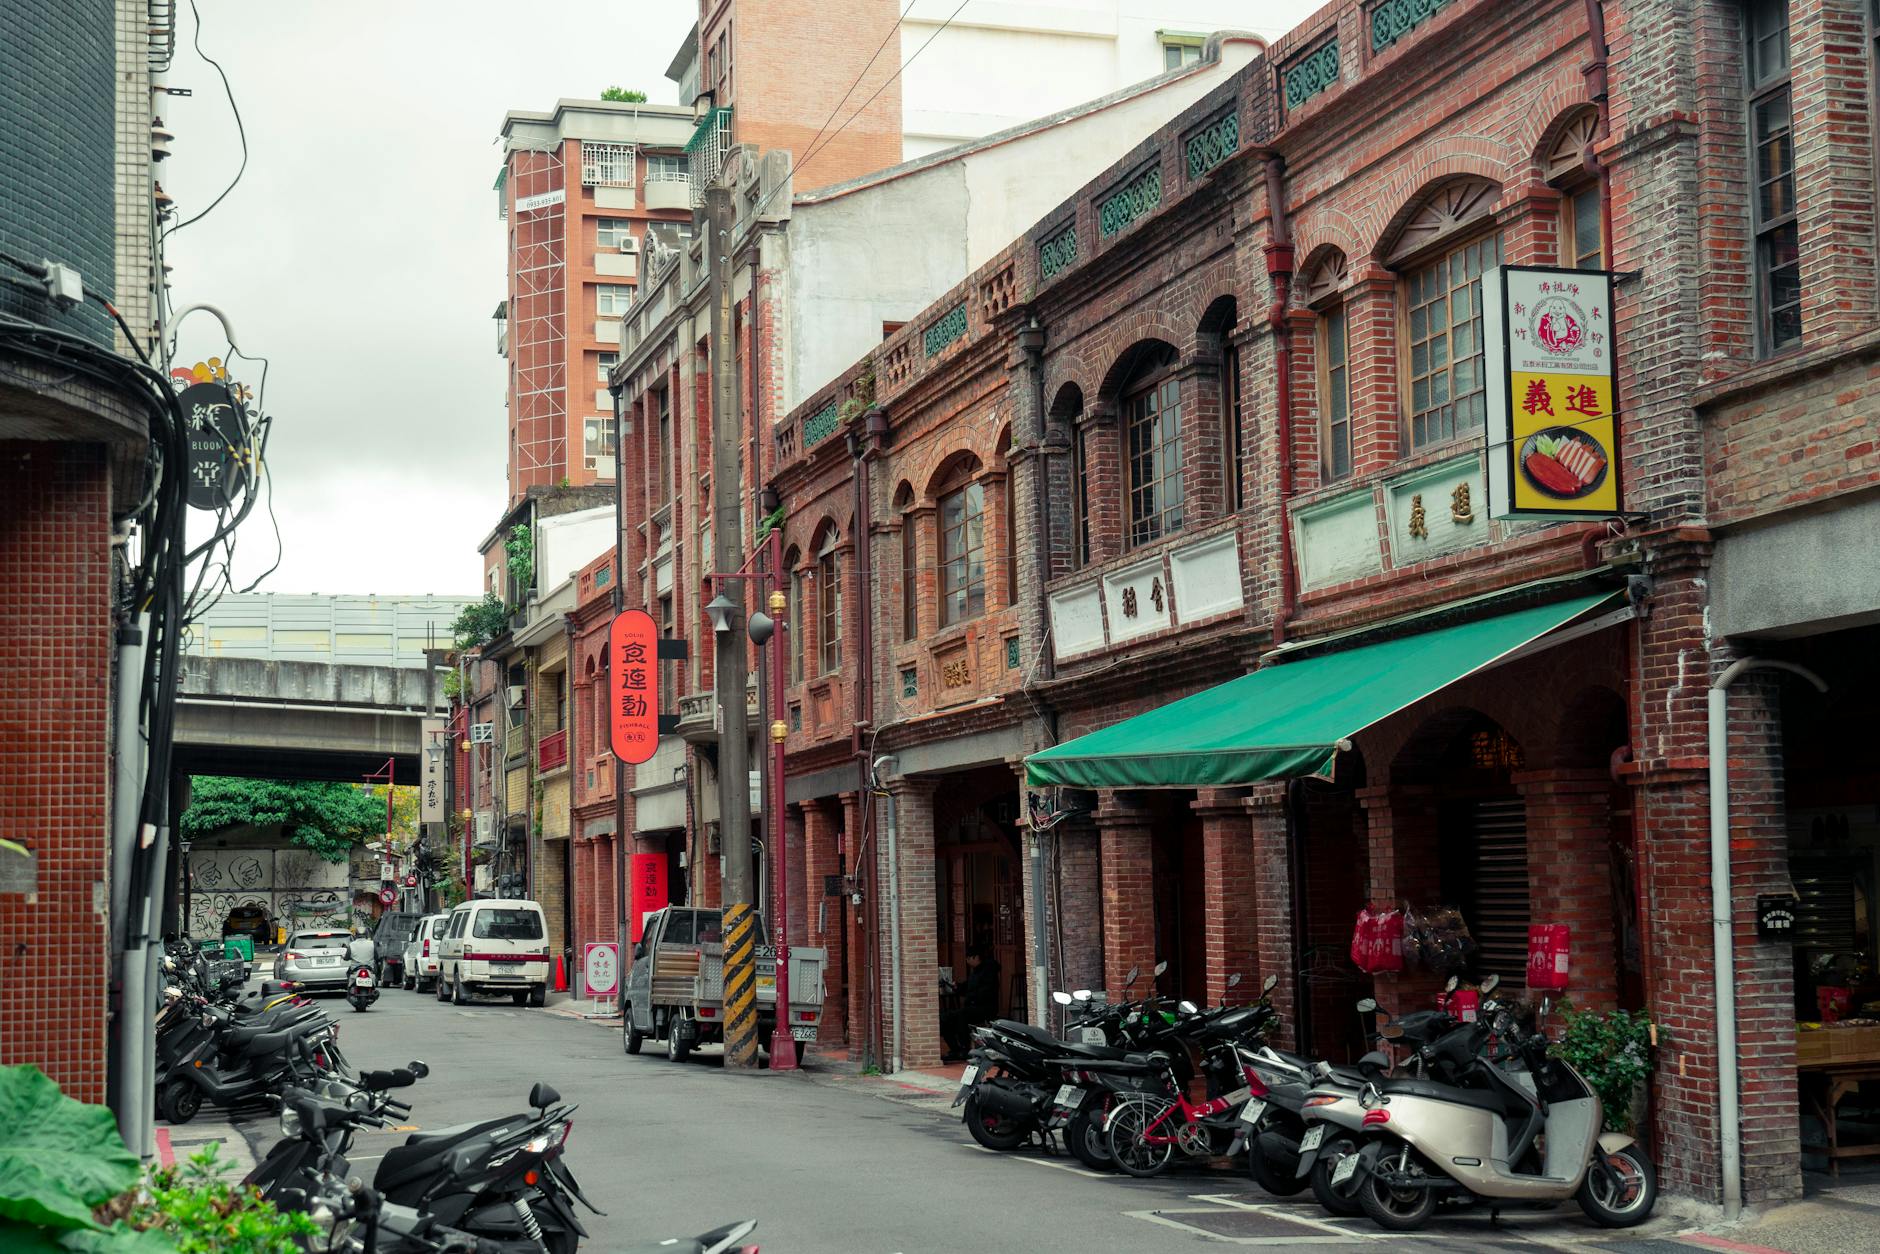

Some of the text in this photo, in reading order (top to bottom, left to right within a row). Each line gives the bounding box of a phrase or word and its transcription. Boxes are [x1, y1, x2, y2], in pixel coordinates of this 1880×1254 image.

[1513, 301, 1527, 341] 新竹
[1591, 306, 1603, 344] 米粉
[1522, 378, 1603, 417] 義進
[192, 441, 221, 450] BLOOM
